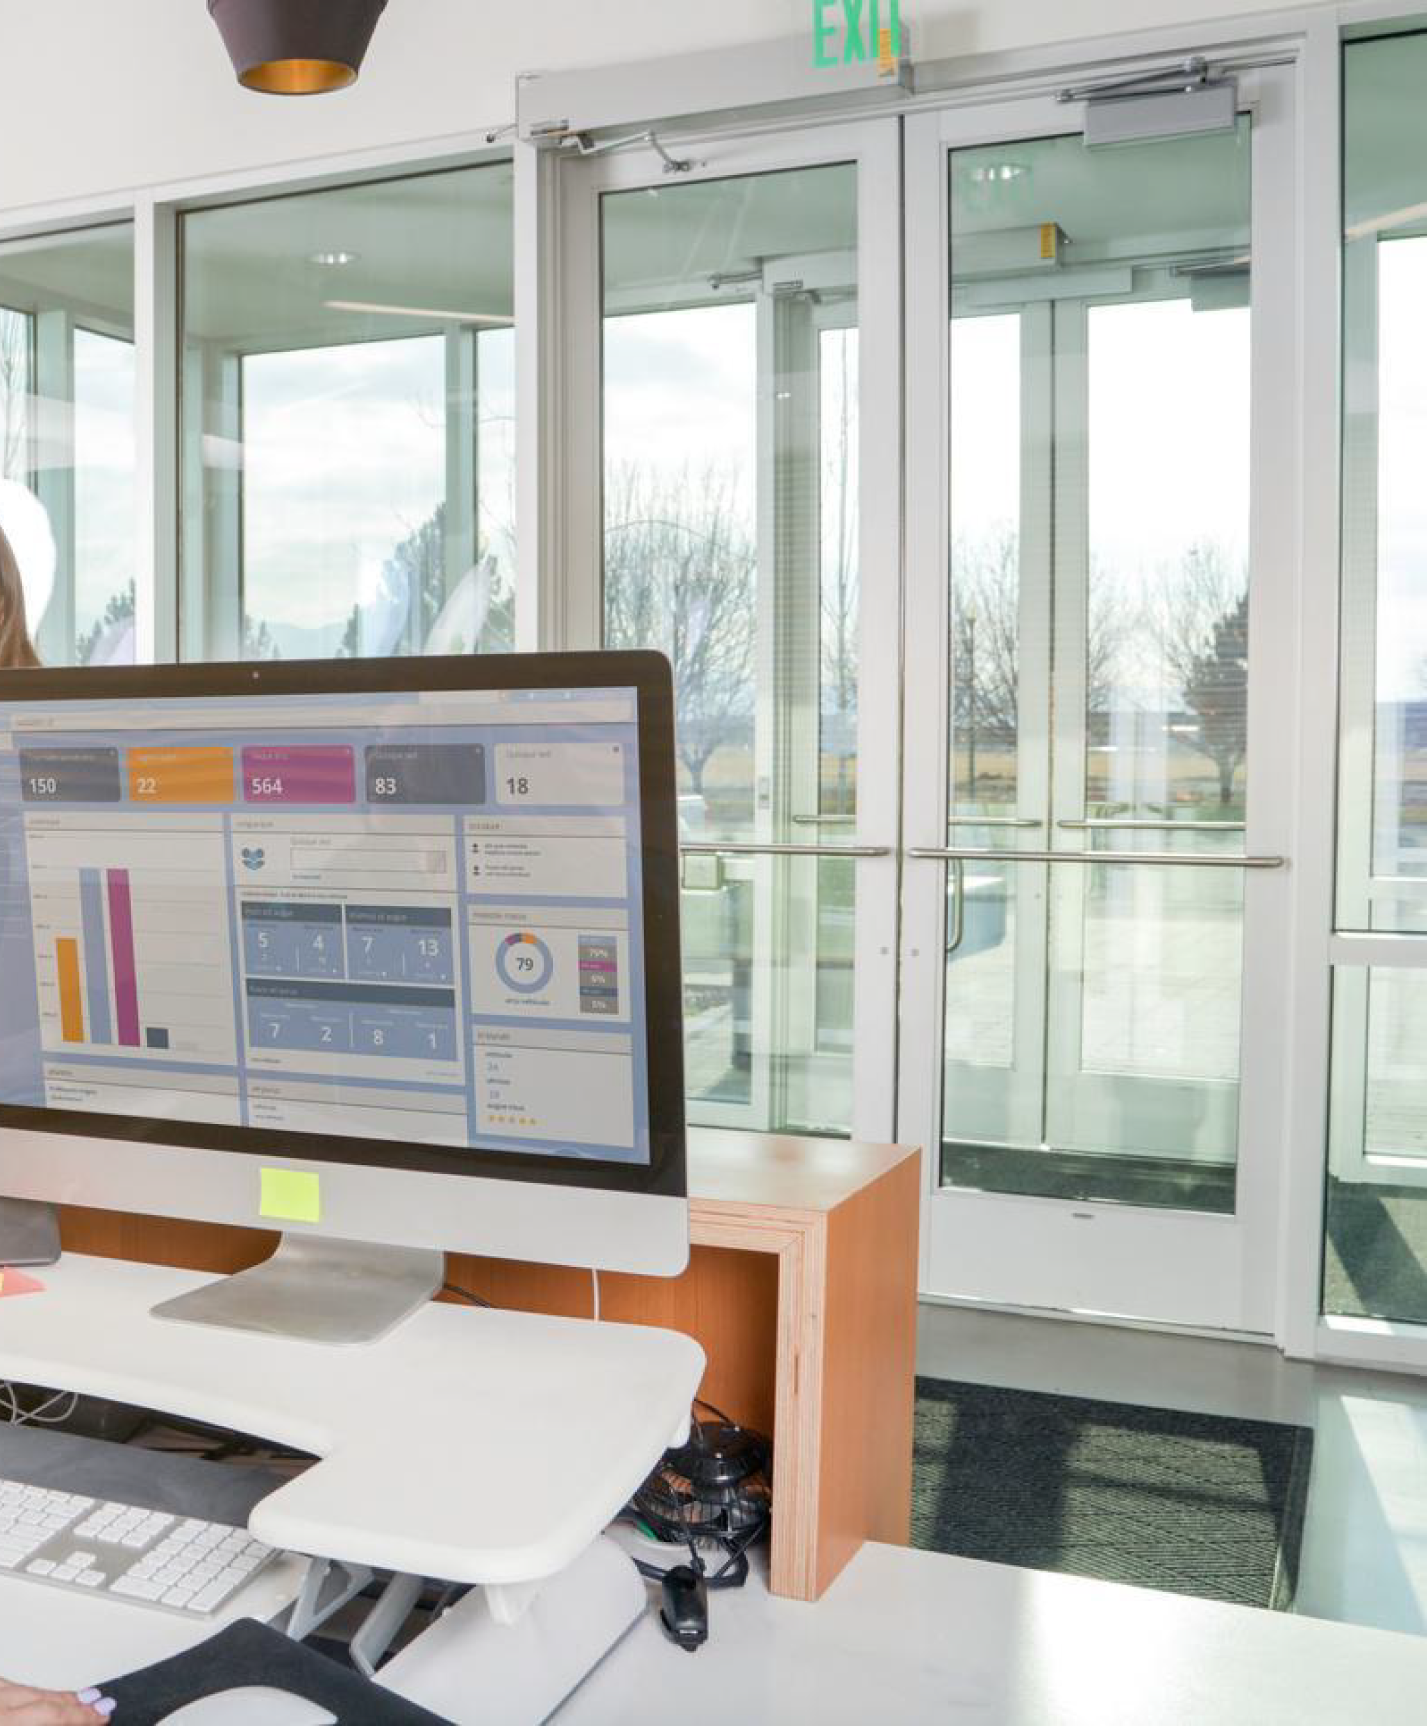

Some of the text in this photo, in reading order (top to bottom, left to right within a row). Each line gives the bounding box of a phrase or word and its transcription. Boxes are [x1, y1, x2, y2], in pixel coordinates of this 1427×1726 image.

[30, 778, 57, 794] 150
[137, 778, 157, 794] 22
[251, 778, 284, 795] 564
[375, 777, 397, 794] 83
[506, 777, 529, 795] 18
[258, 932, 269, 948] 5
[312, 934, 324, 949] 4
[361, 936, 373, 953] 7
[418, 939, 440, 957] 13
[515, 957, 534, 971] 79
[268, 1023, 280, 1039] 7
[321, 1026, 332, 1043] 2
[373, 1029, 384, 1046] 8
[428, 1033, 437, 1050] 1
